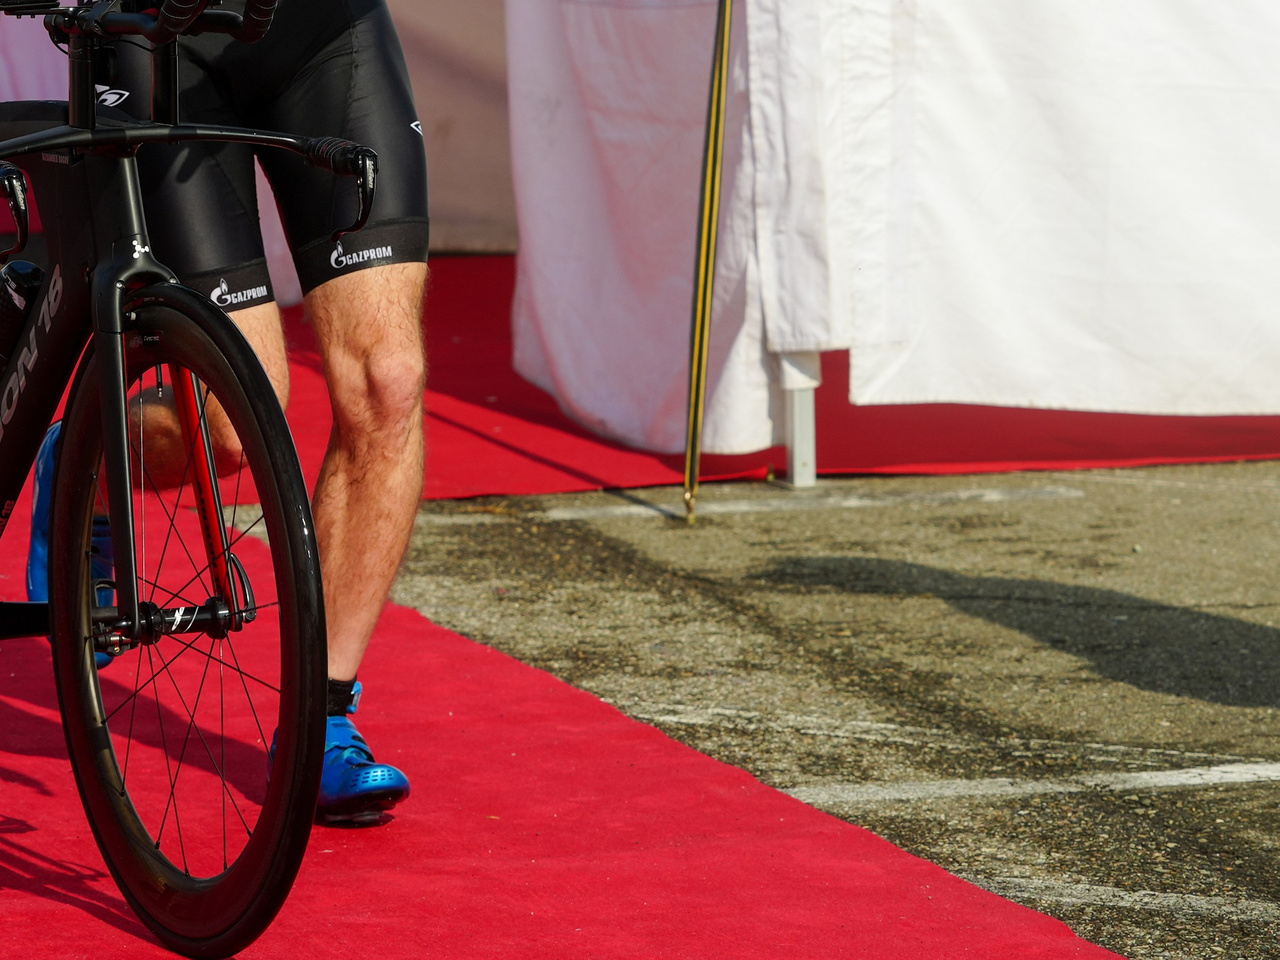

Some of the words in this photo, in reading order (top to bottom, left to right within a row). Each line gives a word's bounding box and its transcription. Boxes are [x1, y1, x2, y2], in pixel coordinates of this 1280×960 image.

[346, 245, 393, 265] GAZPROM
[37, 263, 63, 334] 18
[230, 285, 268, 304] GAZPROM
[2, 499, 15, 517] 18
